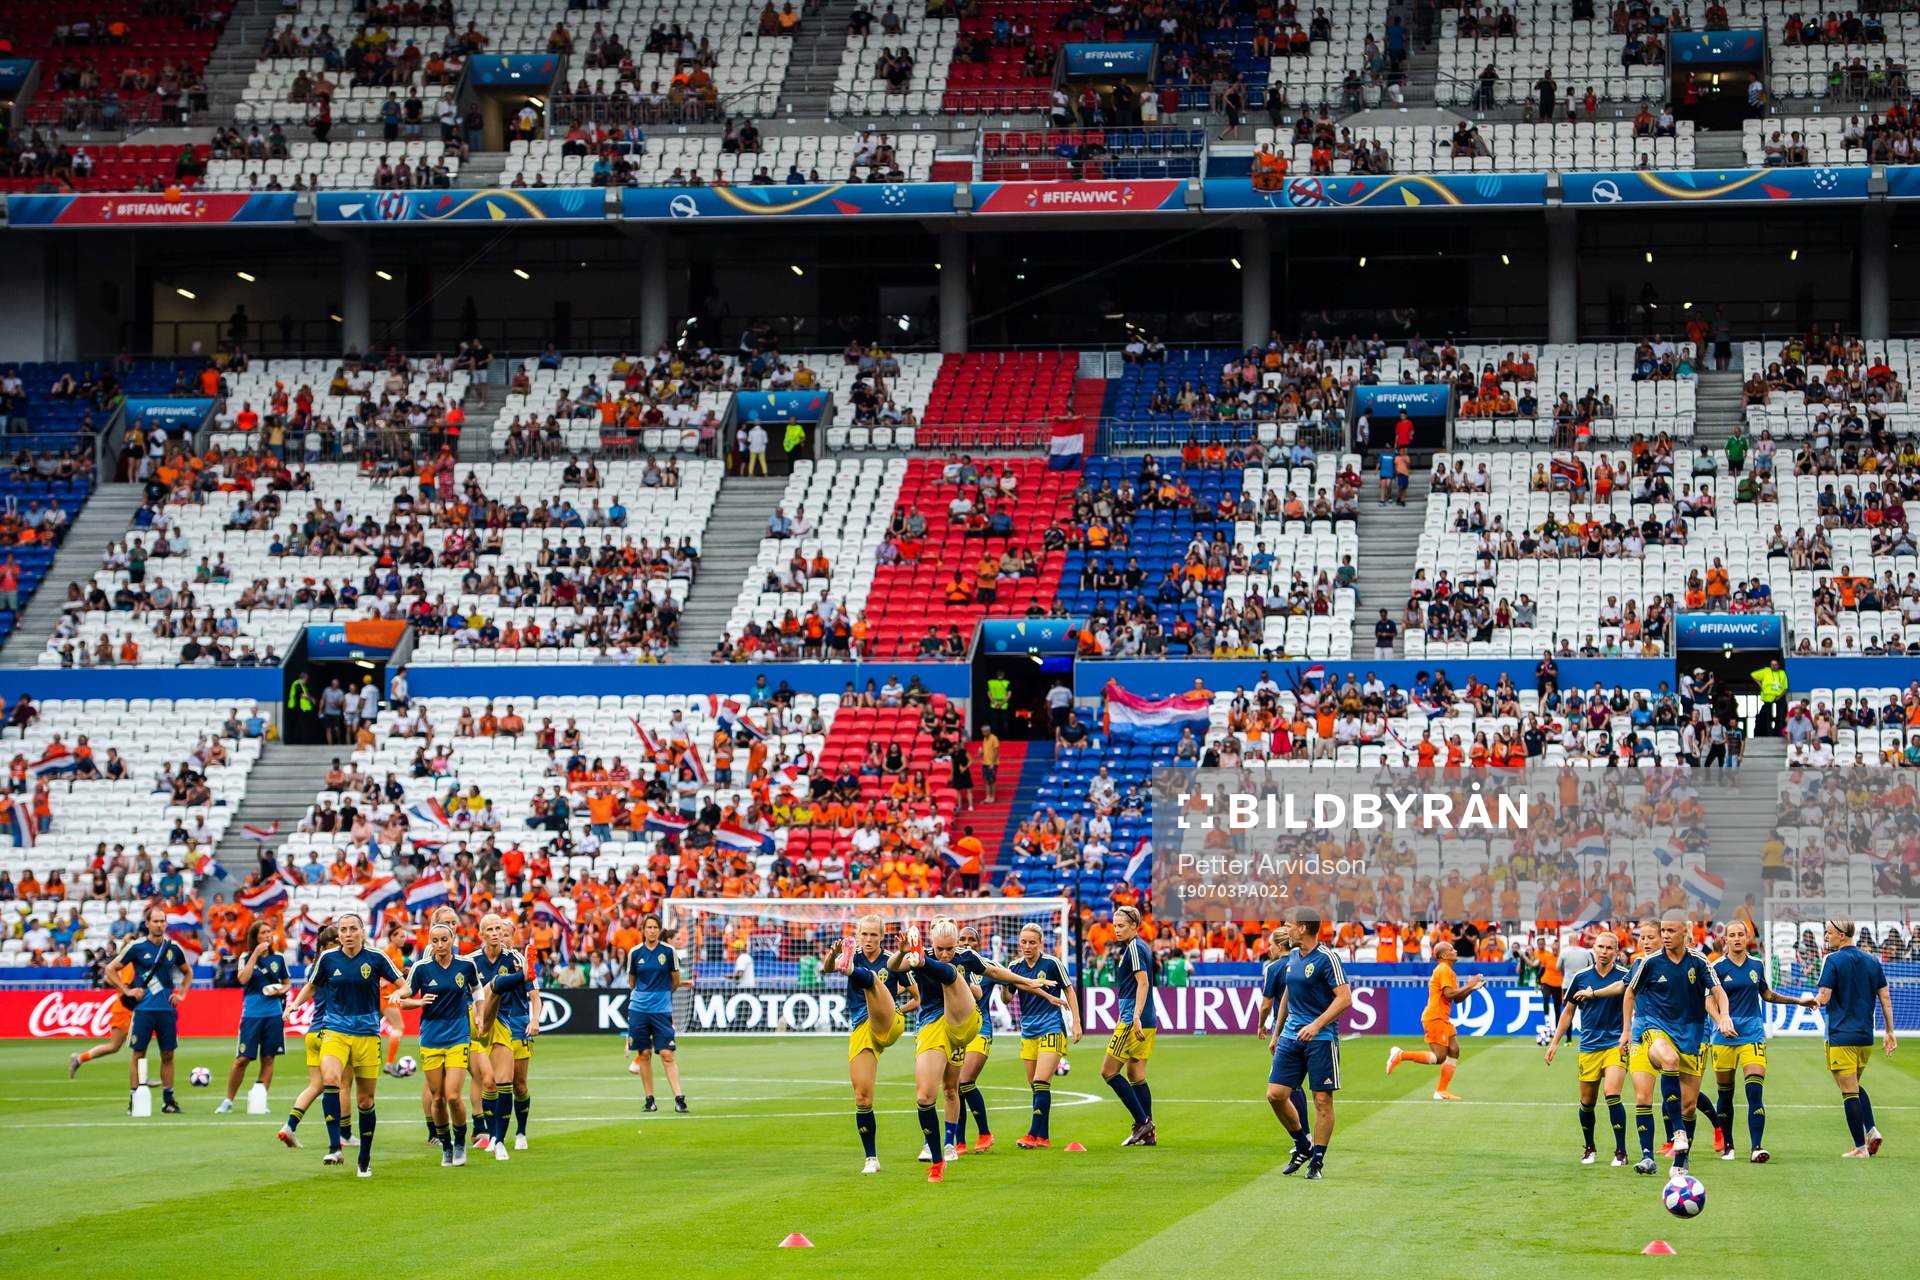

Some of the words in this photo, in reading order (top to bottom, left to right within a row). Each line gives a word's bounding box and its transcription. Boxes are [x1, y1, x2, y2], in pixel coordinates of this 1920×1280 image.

[1085, 51, 1134, 60] #FIFAWWC
[1042, 190, 1118, 203] #FIFAWWC
[117, 203, 191, 215] #FIFAWWC
[1377, 393, 1428, 403] #FIFAWWC
[146, 406, 197, 416] #FIFAWWC
[1699, 623, 1758, 633] #FIFAWWC
[694, 993, 851, 1030] MOTOR
[1152, 986, 1377, 1031] AIRWS
